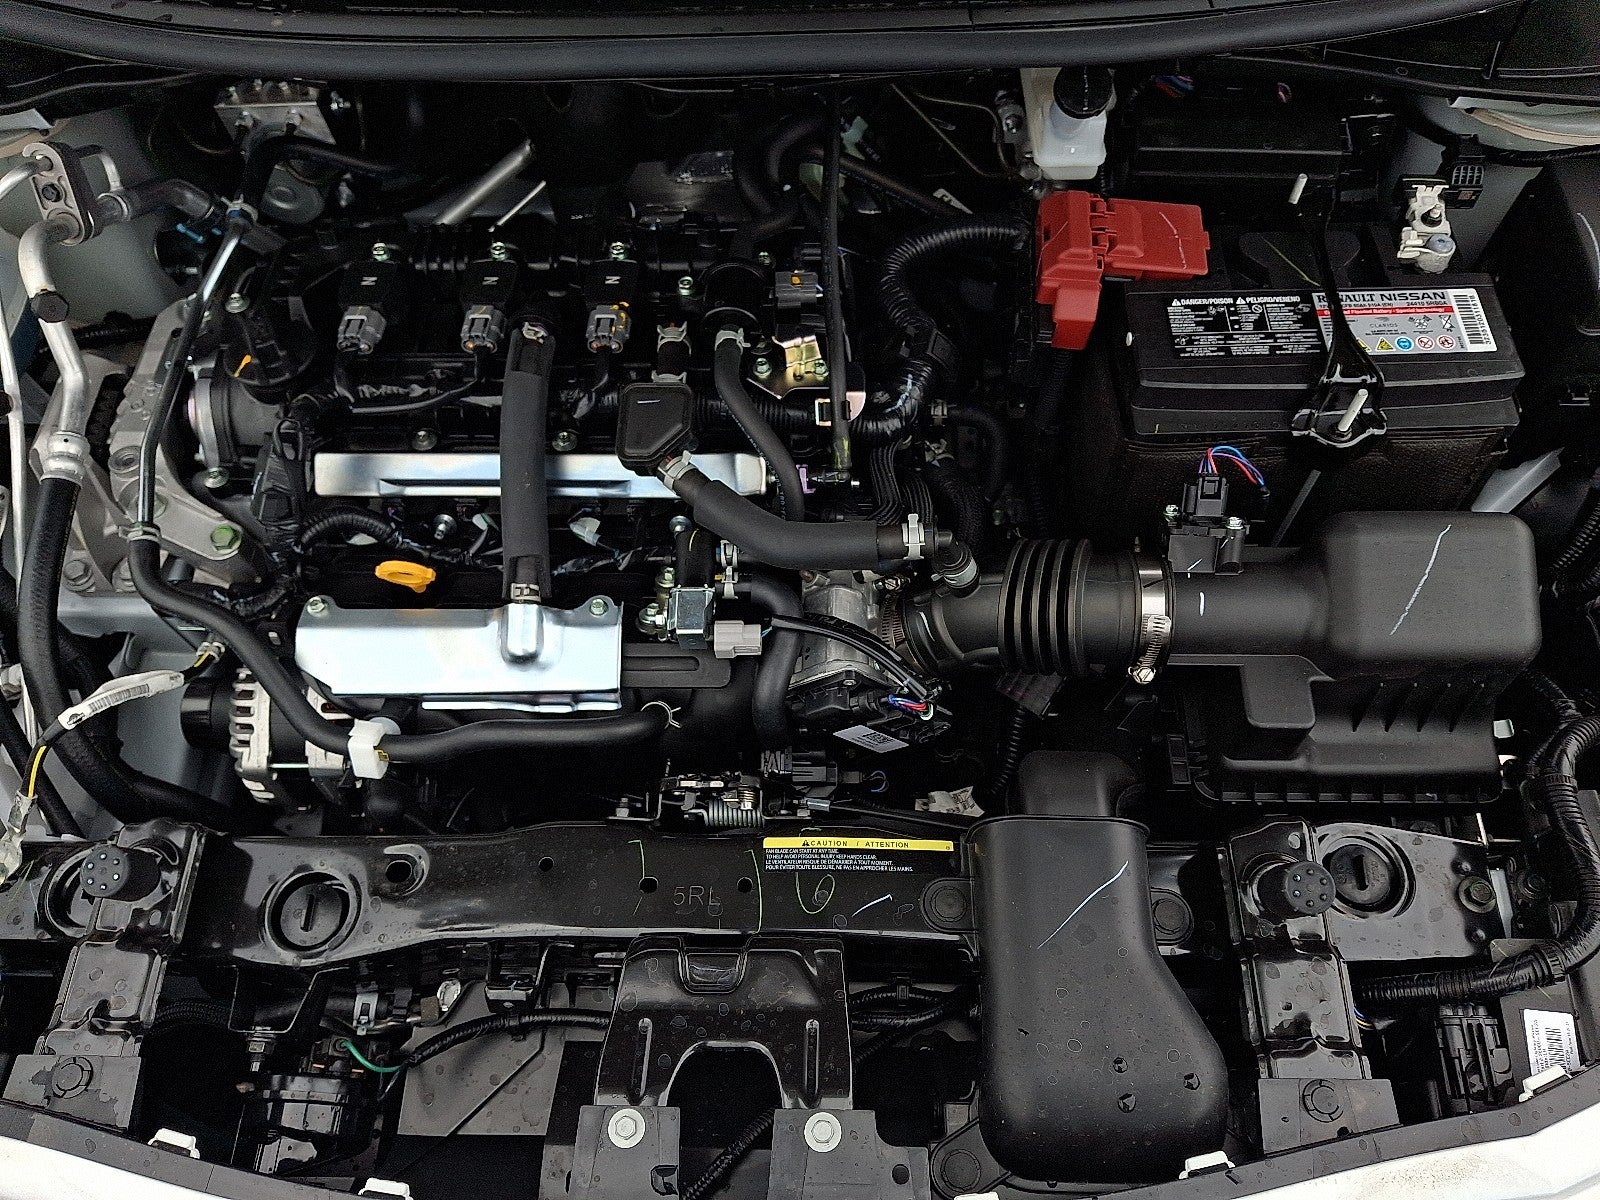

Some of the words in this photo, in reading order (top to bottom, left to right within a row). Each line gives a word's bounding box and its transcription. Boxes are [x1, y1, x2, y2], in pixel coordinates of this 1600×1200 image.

[1245, 295, 1301, 304] PELIGRO/VENENO
[1380, 291, 1446, 301] NISSAN
[1181, 297, 1233, 306] DANGER/POISON
